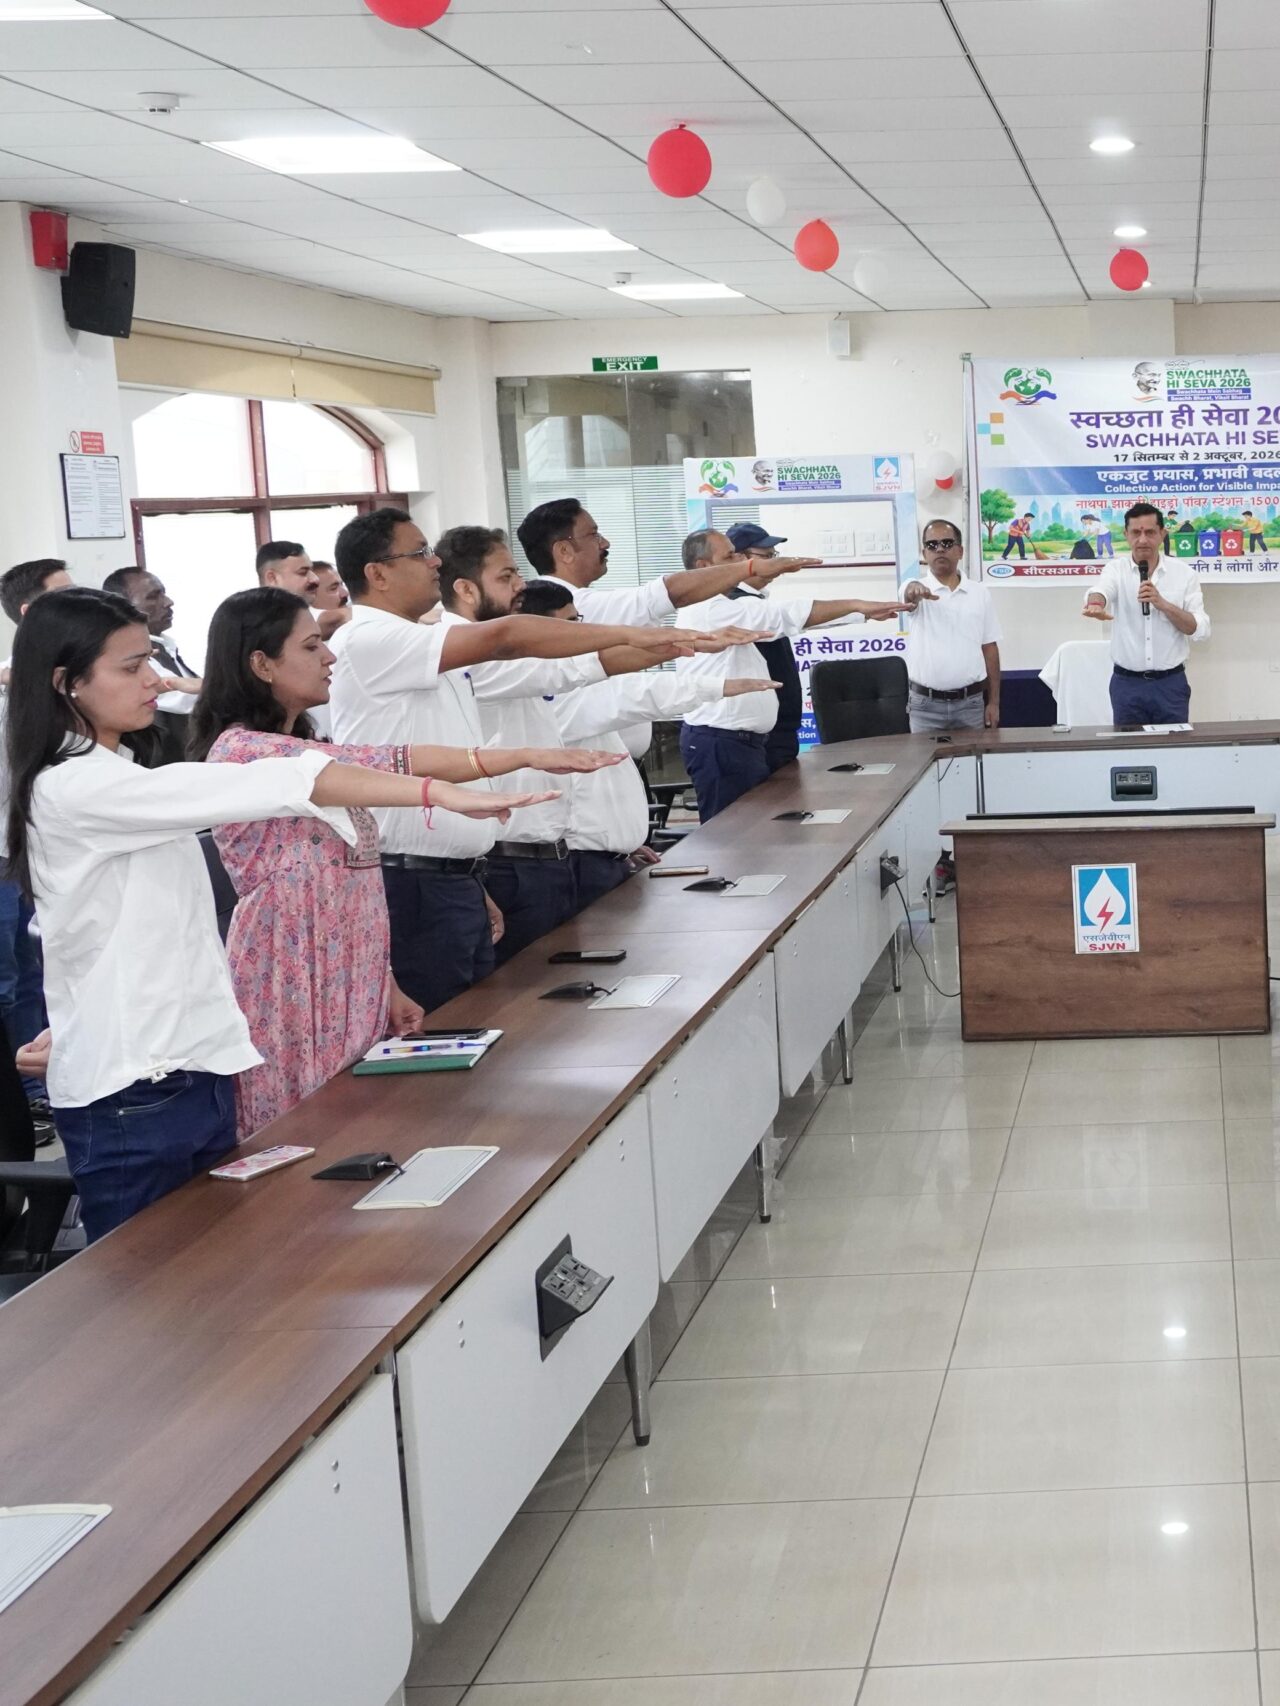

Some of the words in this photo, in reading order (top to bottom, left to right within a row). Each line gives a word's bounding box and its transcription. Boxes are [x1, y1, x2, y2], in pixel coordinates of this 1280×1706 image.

[606, 361, 644, 371] EXIT
[1166, 369, 1248, 379] SWACHHATA
[1167, 380, 1180, 389] HI
[1184, 379, 1217, 388] SEVA
[1220, 378, 1252, 387] 2026
[1069, 411, 1164, 429] स्वच्छता
[1170, 404, 1195, 429] ही
[1201, 403, 1250, 426] सेवा
[1086, 432, 1220, 448] SWACHHATA
[1226, 431, 1246, 445] HI
[1114, 454, 1128, 462] 17
[1133, 451, 1175, 462] सितम्बर
[1179, 450, 1189, 461] से
[1193, 452, 1200, 460] 2
[1204, 452, 1247, 462] अक्टूबर,
[777, 465, 838, 475] SWACHHATA
[1096, 470, 1149, 484] एकजुट
[1152, 469, 1198, 481] प्रयास,
[1202, 465, 1249, 480] प्रभावी
[818, 472, 841, 480] 2026
[1105, 484, 1158, 493] Collective
[1161, 483, 1196, 492] Action
[1199, 483, 1214, 491] for
[1217, 482, 1253, 490] Visible
[1076, 499, 1107, 508] नाथपा
[1022, 566, 1080, 575] सीएसआर
[1214, 559, 1223, 572] में
[1226, 558, 1253, 572] लोगों
[1258, 558, 1279, 572] और
[794, 637, 812, 656] ही
[817, 636, 854, 654] सेवा
[859, 638, 906, 652] 2026
[1083, 932, 1131, 943] एसजेवीएन
[1089, 943, 1126, 951] SJVN
